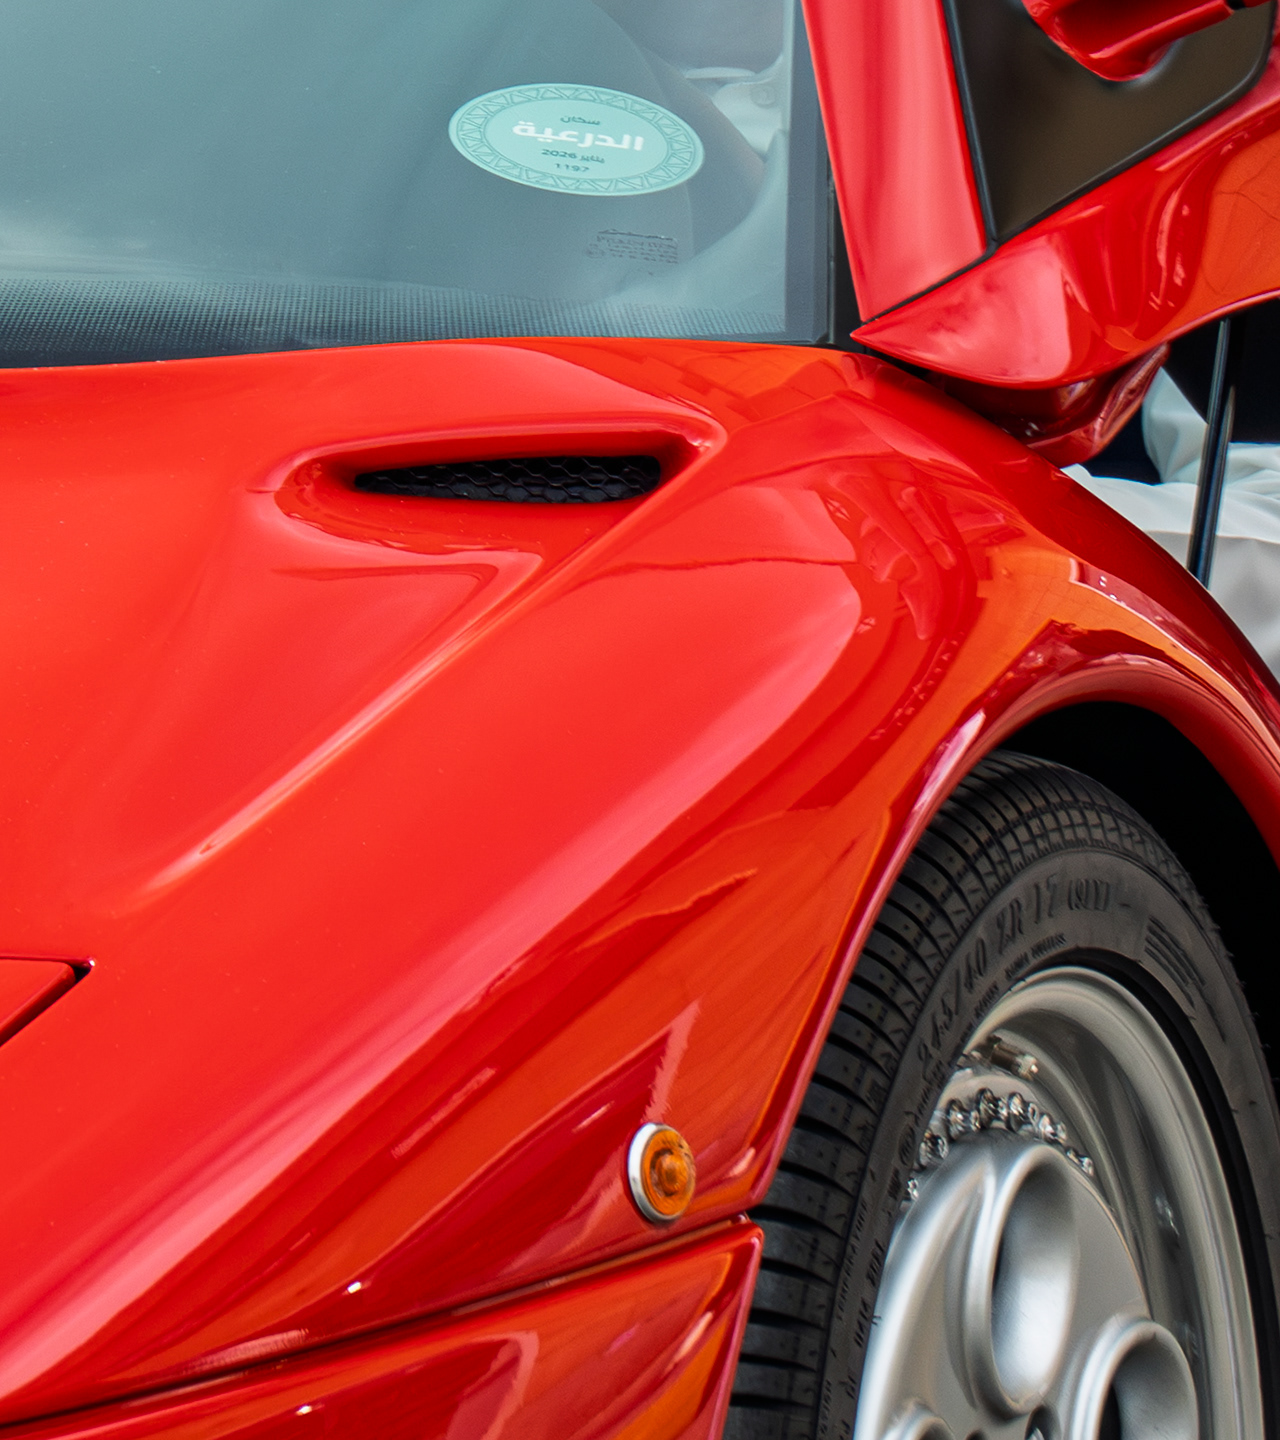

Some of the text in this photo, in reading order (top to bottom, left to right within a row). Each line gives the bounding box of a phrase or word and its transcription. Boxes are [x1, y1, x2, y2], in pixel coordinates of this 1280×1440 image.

[560, 115, 602, 127] سكان
[512, 120, 645, 151] الدرعية
[541, 148, 577, 159] 2026
[554, 162, 590, 173] 1197
